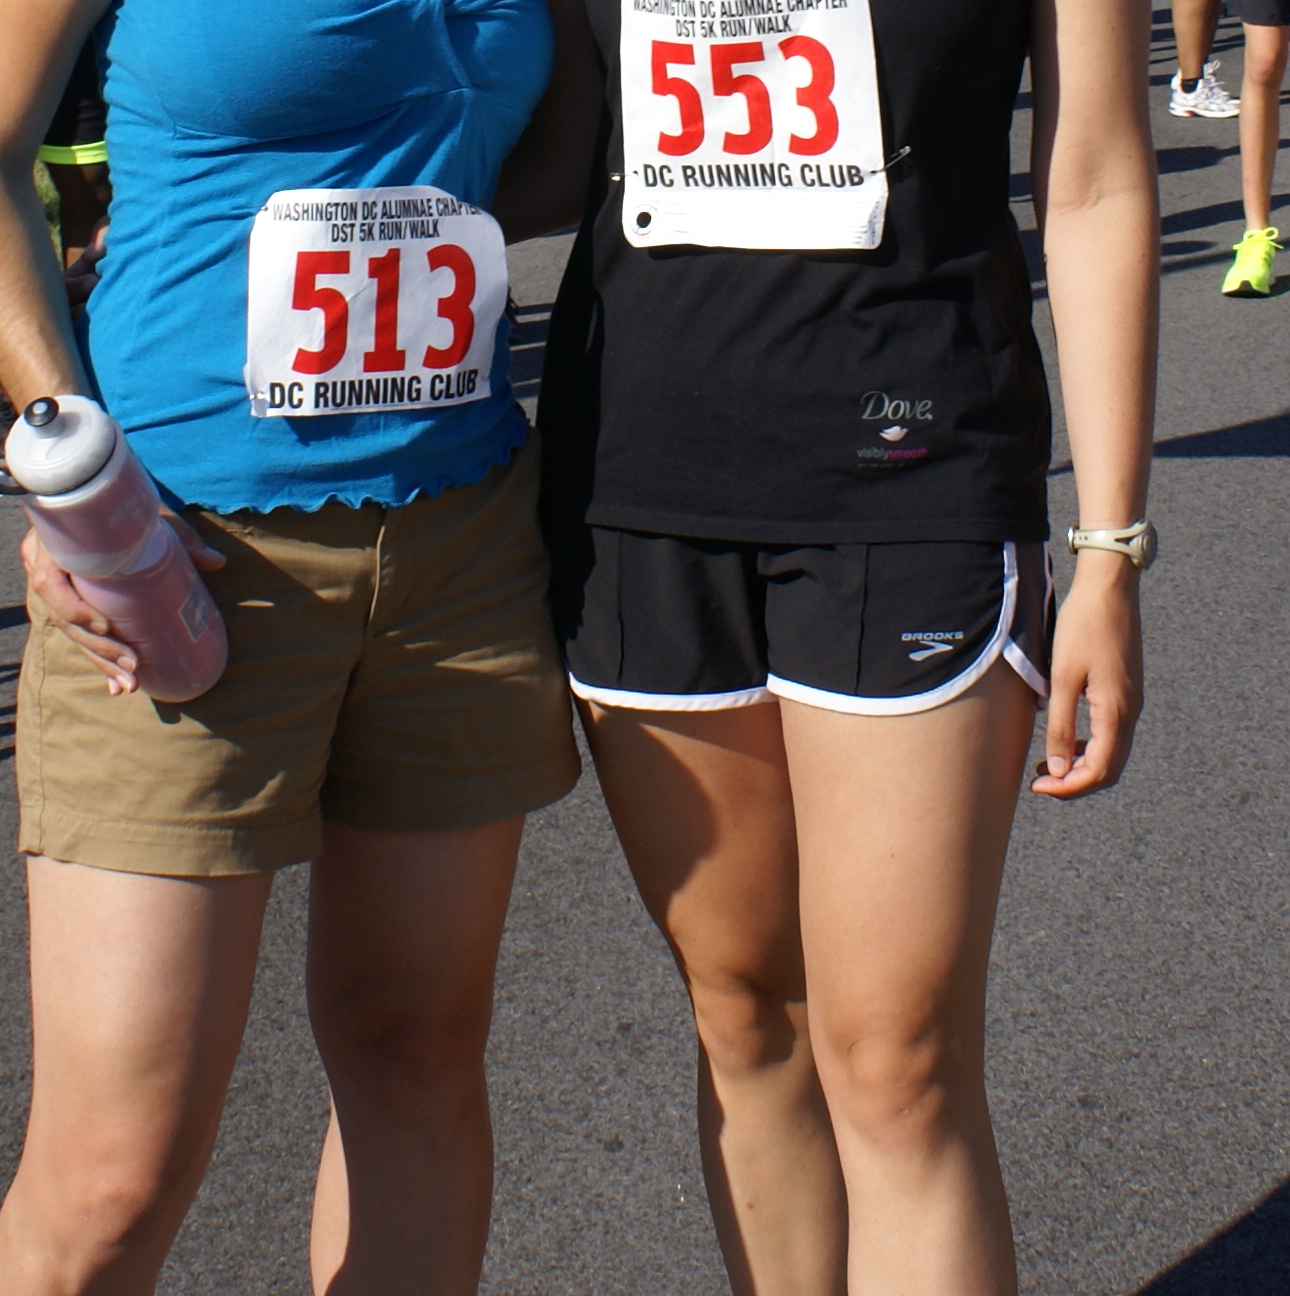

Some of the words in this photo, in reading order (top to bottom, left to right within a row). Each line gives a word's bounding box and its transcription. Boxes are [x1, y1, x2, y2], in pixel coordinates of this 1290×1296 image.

[699, 0, 717, 19] DC
[675, 19, 697, 38] DST
[700, 20, 718, 39] 5K
[720, 14, 793, 38] RUN/WALK
[651, 34, 840, 157] 553
[642, 162, 675, 188] DC
[681, 161, 794, 188] RUNNING
[800, 162, 866, 188] CLUB
[272, 201, 358, 222] WASHINGTON
[361, 200, 379, 219] DC
[380, 197, 434, 218] ALUMNAE
[331, 221, 356, 242] DST
[358, 221, 376, 242] 5K
[378, 218, 441, 242] RUN/WALK
[291, 244, 477, 375] 513
[268, 380, 305, 410] DC
[313, 374, 422, 409] RUNNING
[429, 368, 480, 402] CLUB
[859, 390, 934, 420] Dove
[900, 630, 965, 642] BROOKS
